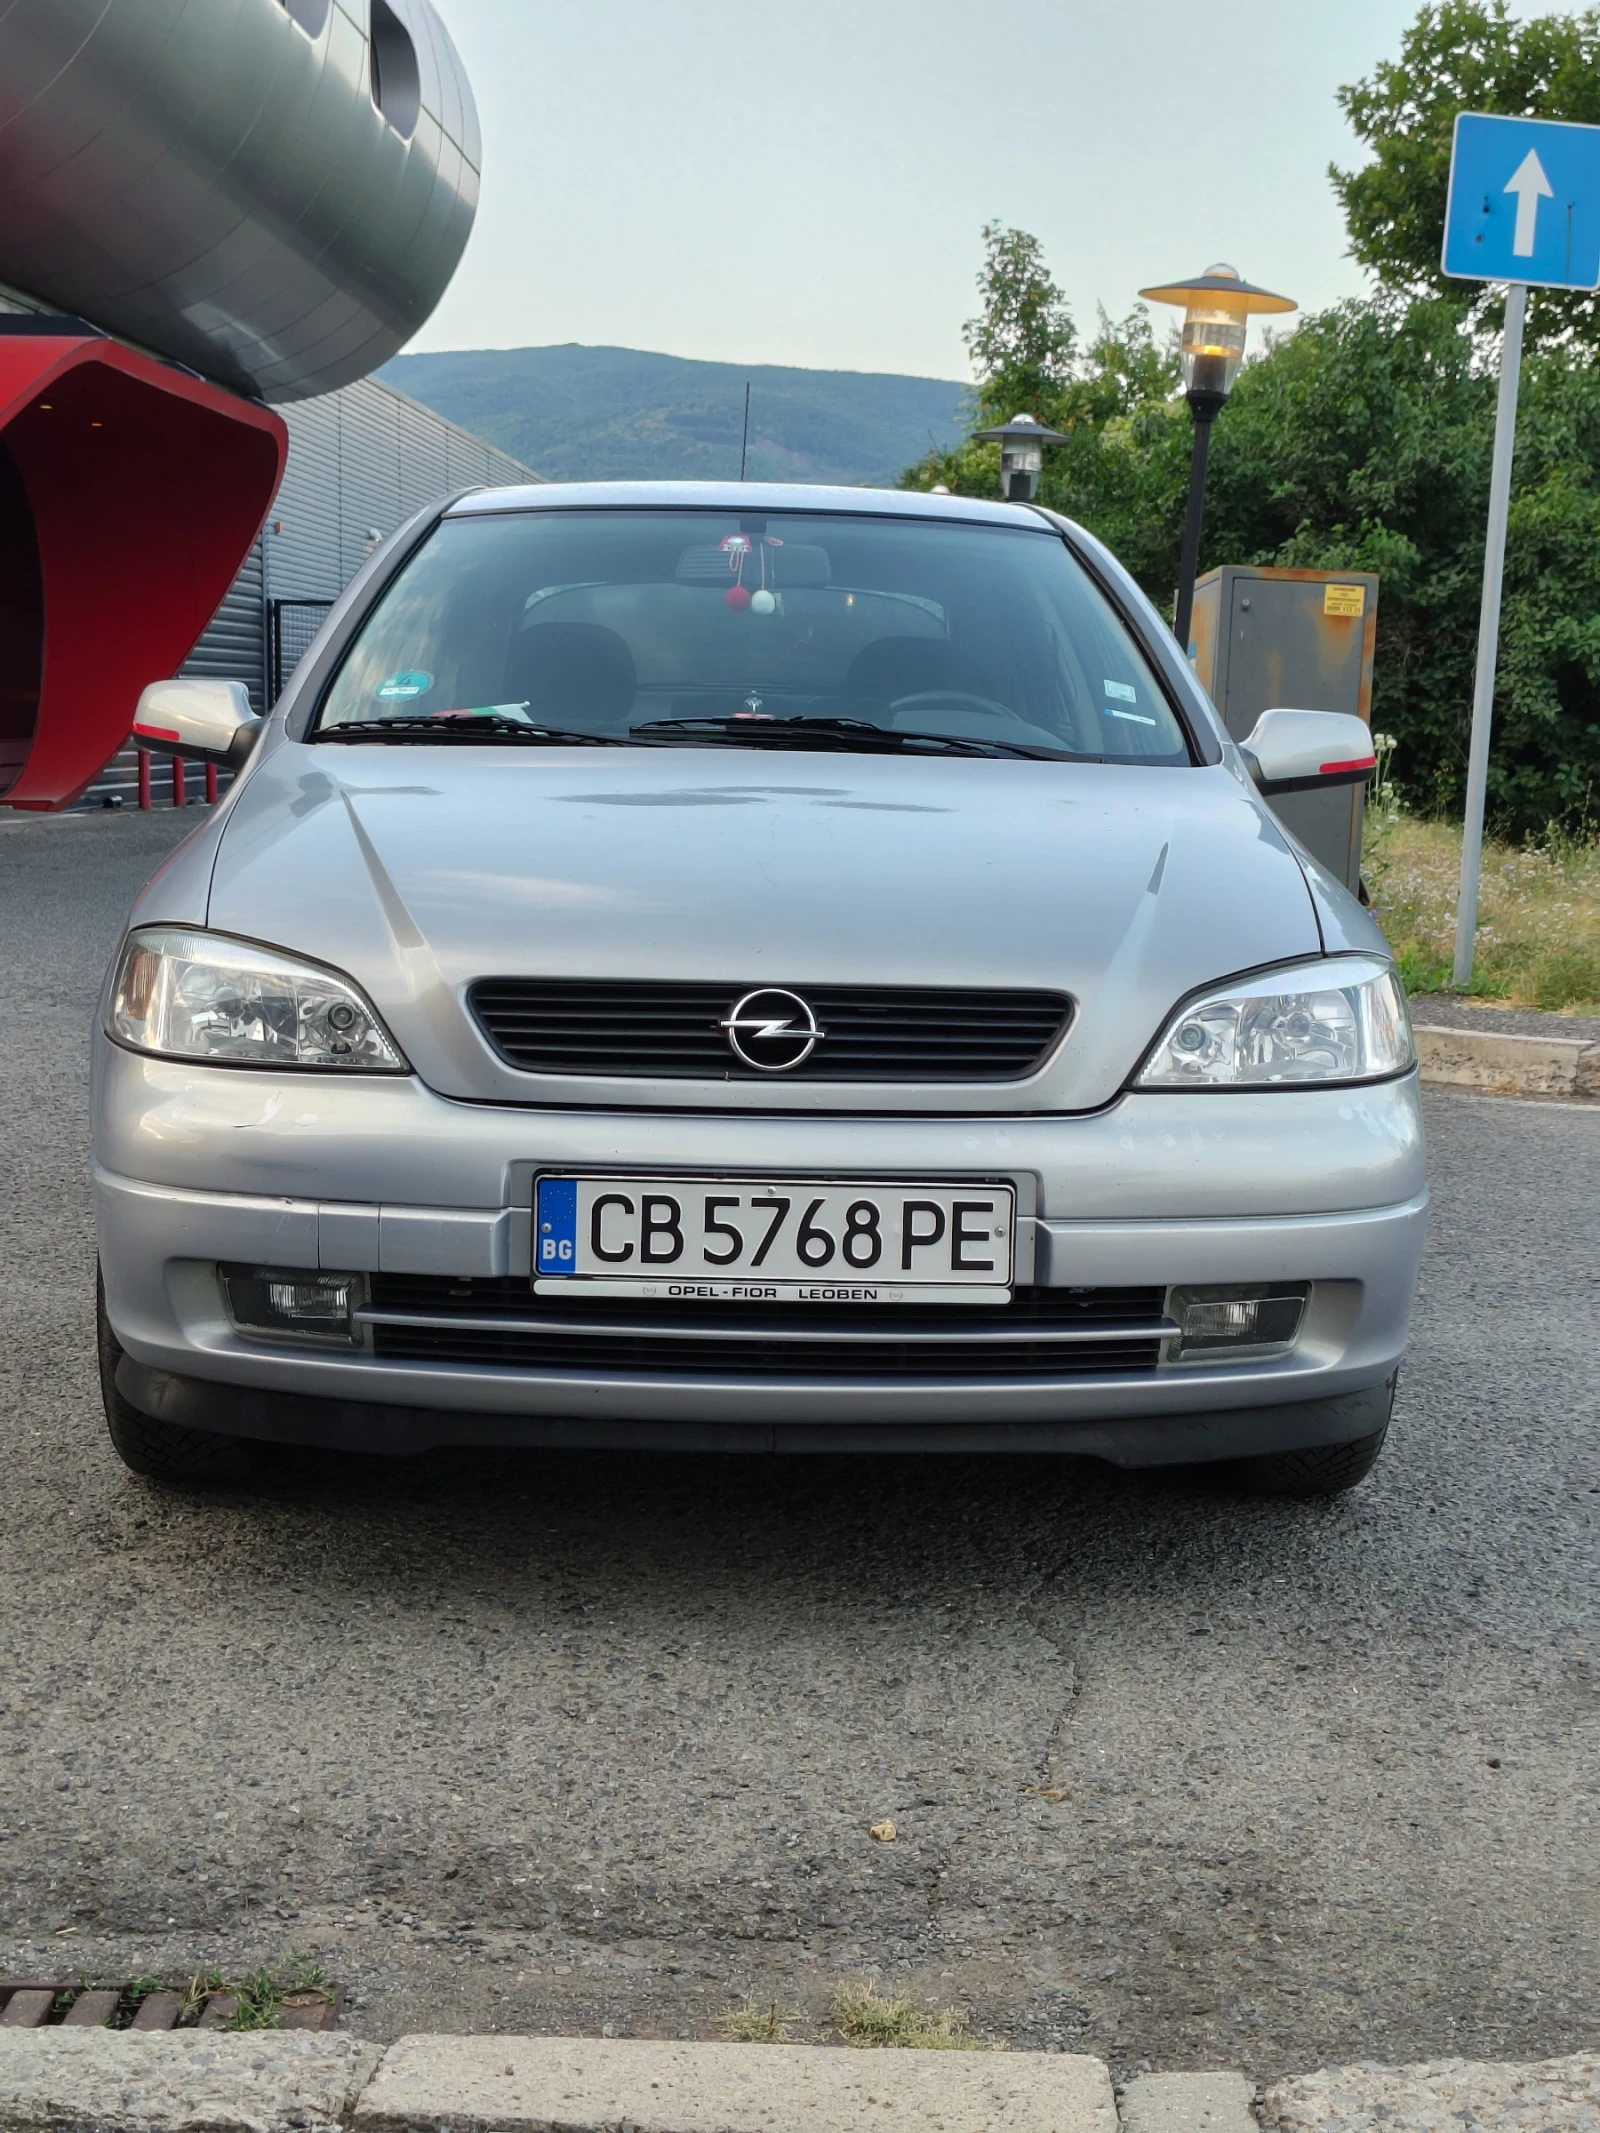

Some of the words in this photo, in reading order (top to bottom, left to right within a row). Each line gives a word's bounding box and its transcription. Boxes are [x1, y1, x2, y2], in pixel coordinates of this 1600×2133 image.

[590, 1193, 685, 1264] CB
[703, 1197, 882, 1269] 5768
[901, 1200, 995, 1271] PE
[542, 1239, 572, 1260] BG
[798, 1288, 878, 1300] LEOBEN
